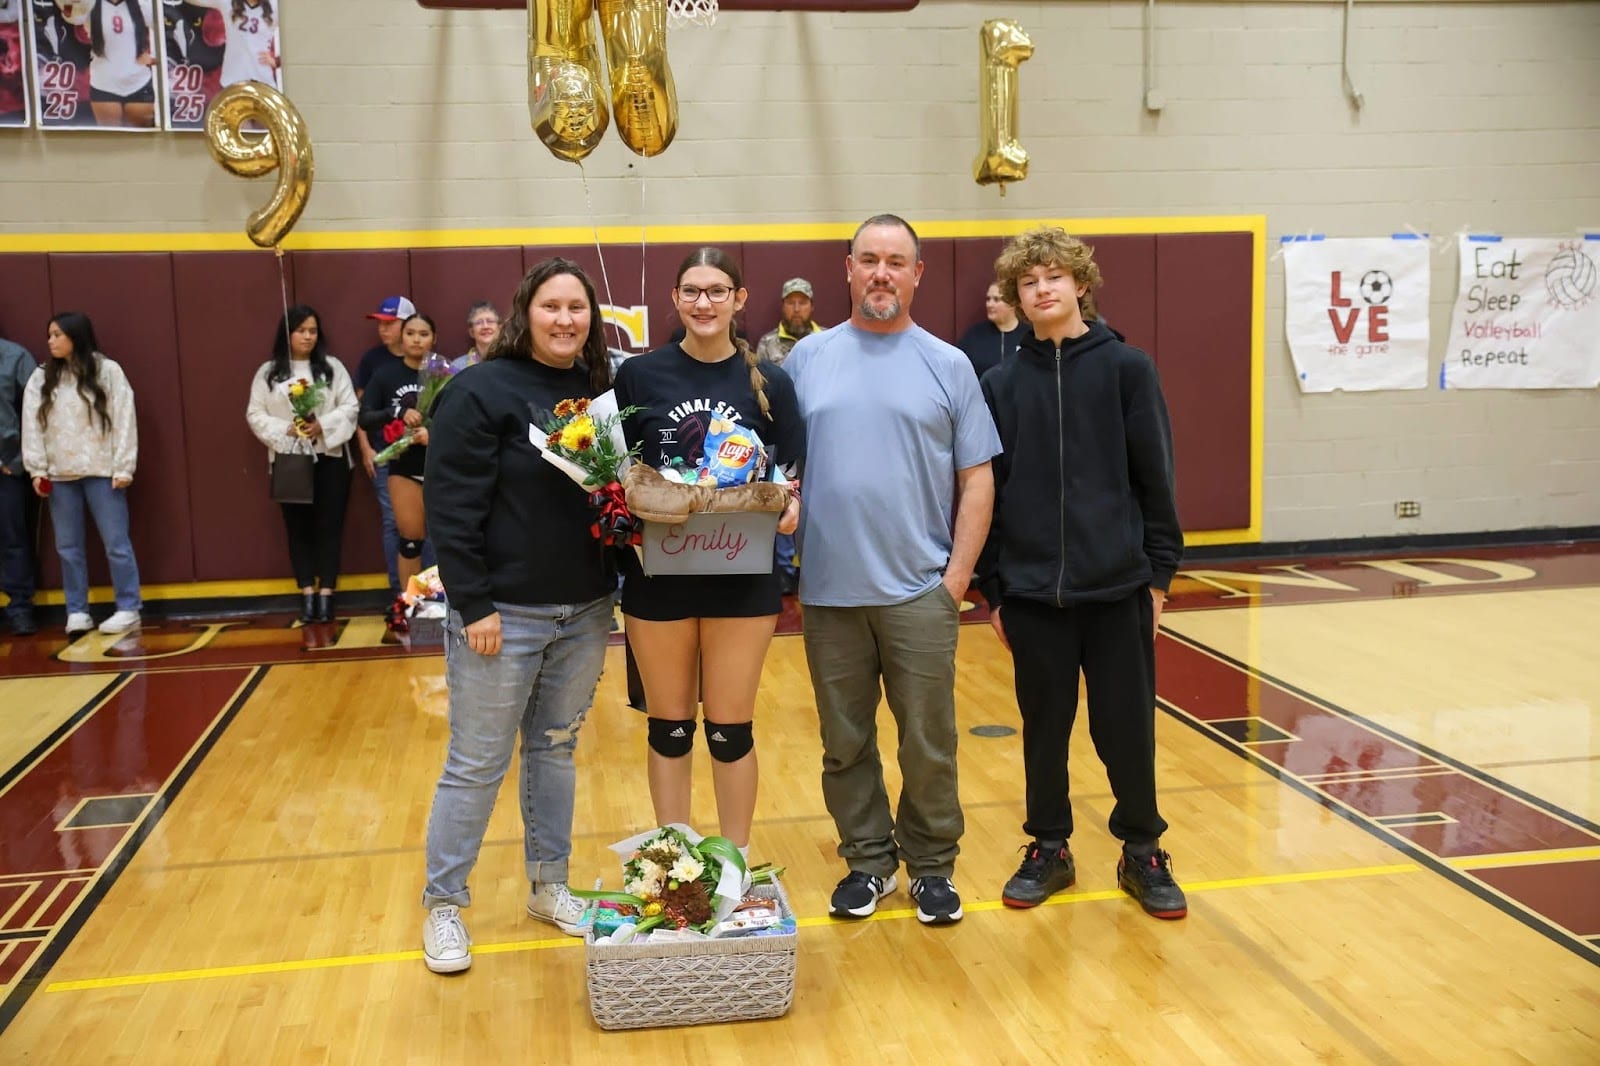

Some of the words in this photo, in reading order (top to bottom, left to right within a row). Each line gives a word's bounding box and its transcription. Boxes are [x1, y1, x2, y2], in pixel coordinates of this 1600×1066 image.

[112, 15, 124, 34] 9
[238, 15, 259, 34] 23
[43, 61, 76, 90] 20
[172, 64, 204, 94] 20
[43, 91, 78, 119] 25
[172, 94, 206, 122] 25
[1475, 247, 1522, 280] Eat
[1467, 285, 1521, 314] Sleep
[1464, 320, 1542, 341] Volleyball
[1461, 347, 1529, 367] Repeat
[396, 384, 418, 397] FINAL
[668, 398, 711, 423] FINAL
[714, 400, 743, 422] SET
[661, 431, 672, 441] 20
[661, 521, 748, 561] Emily
